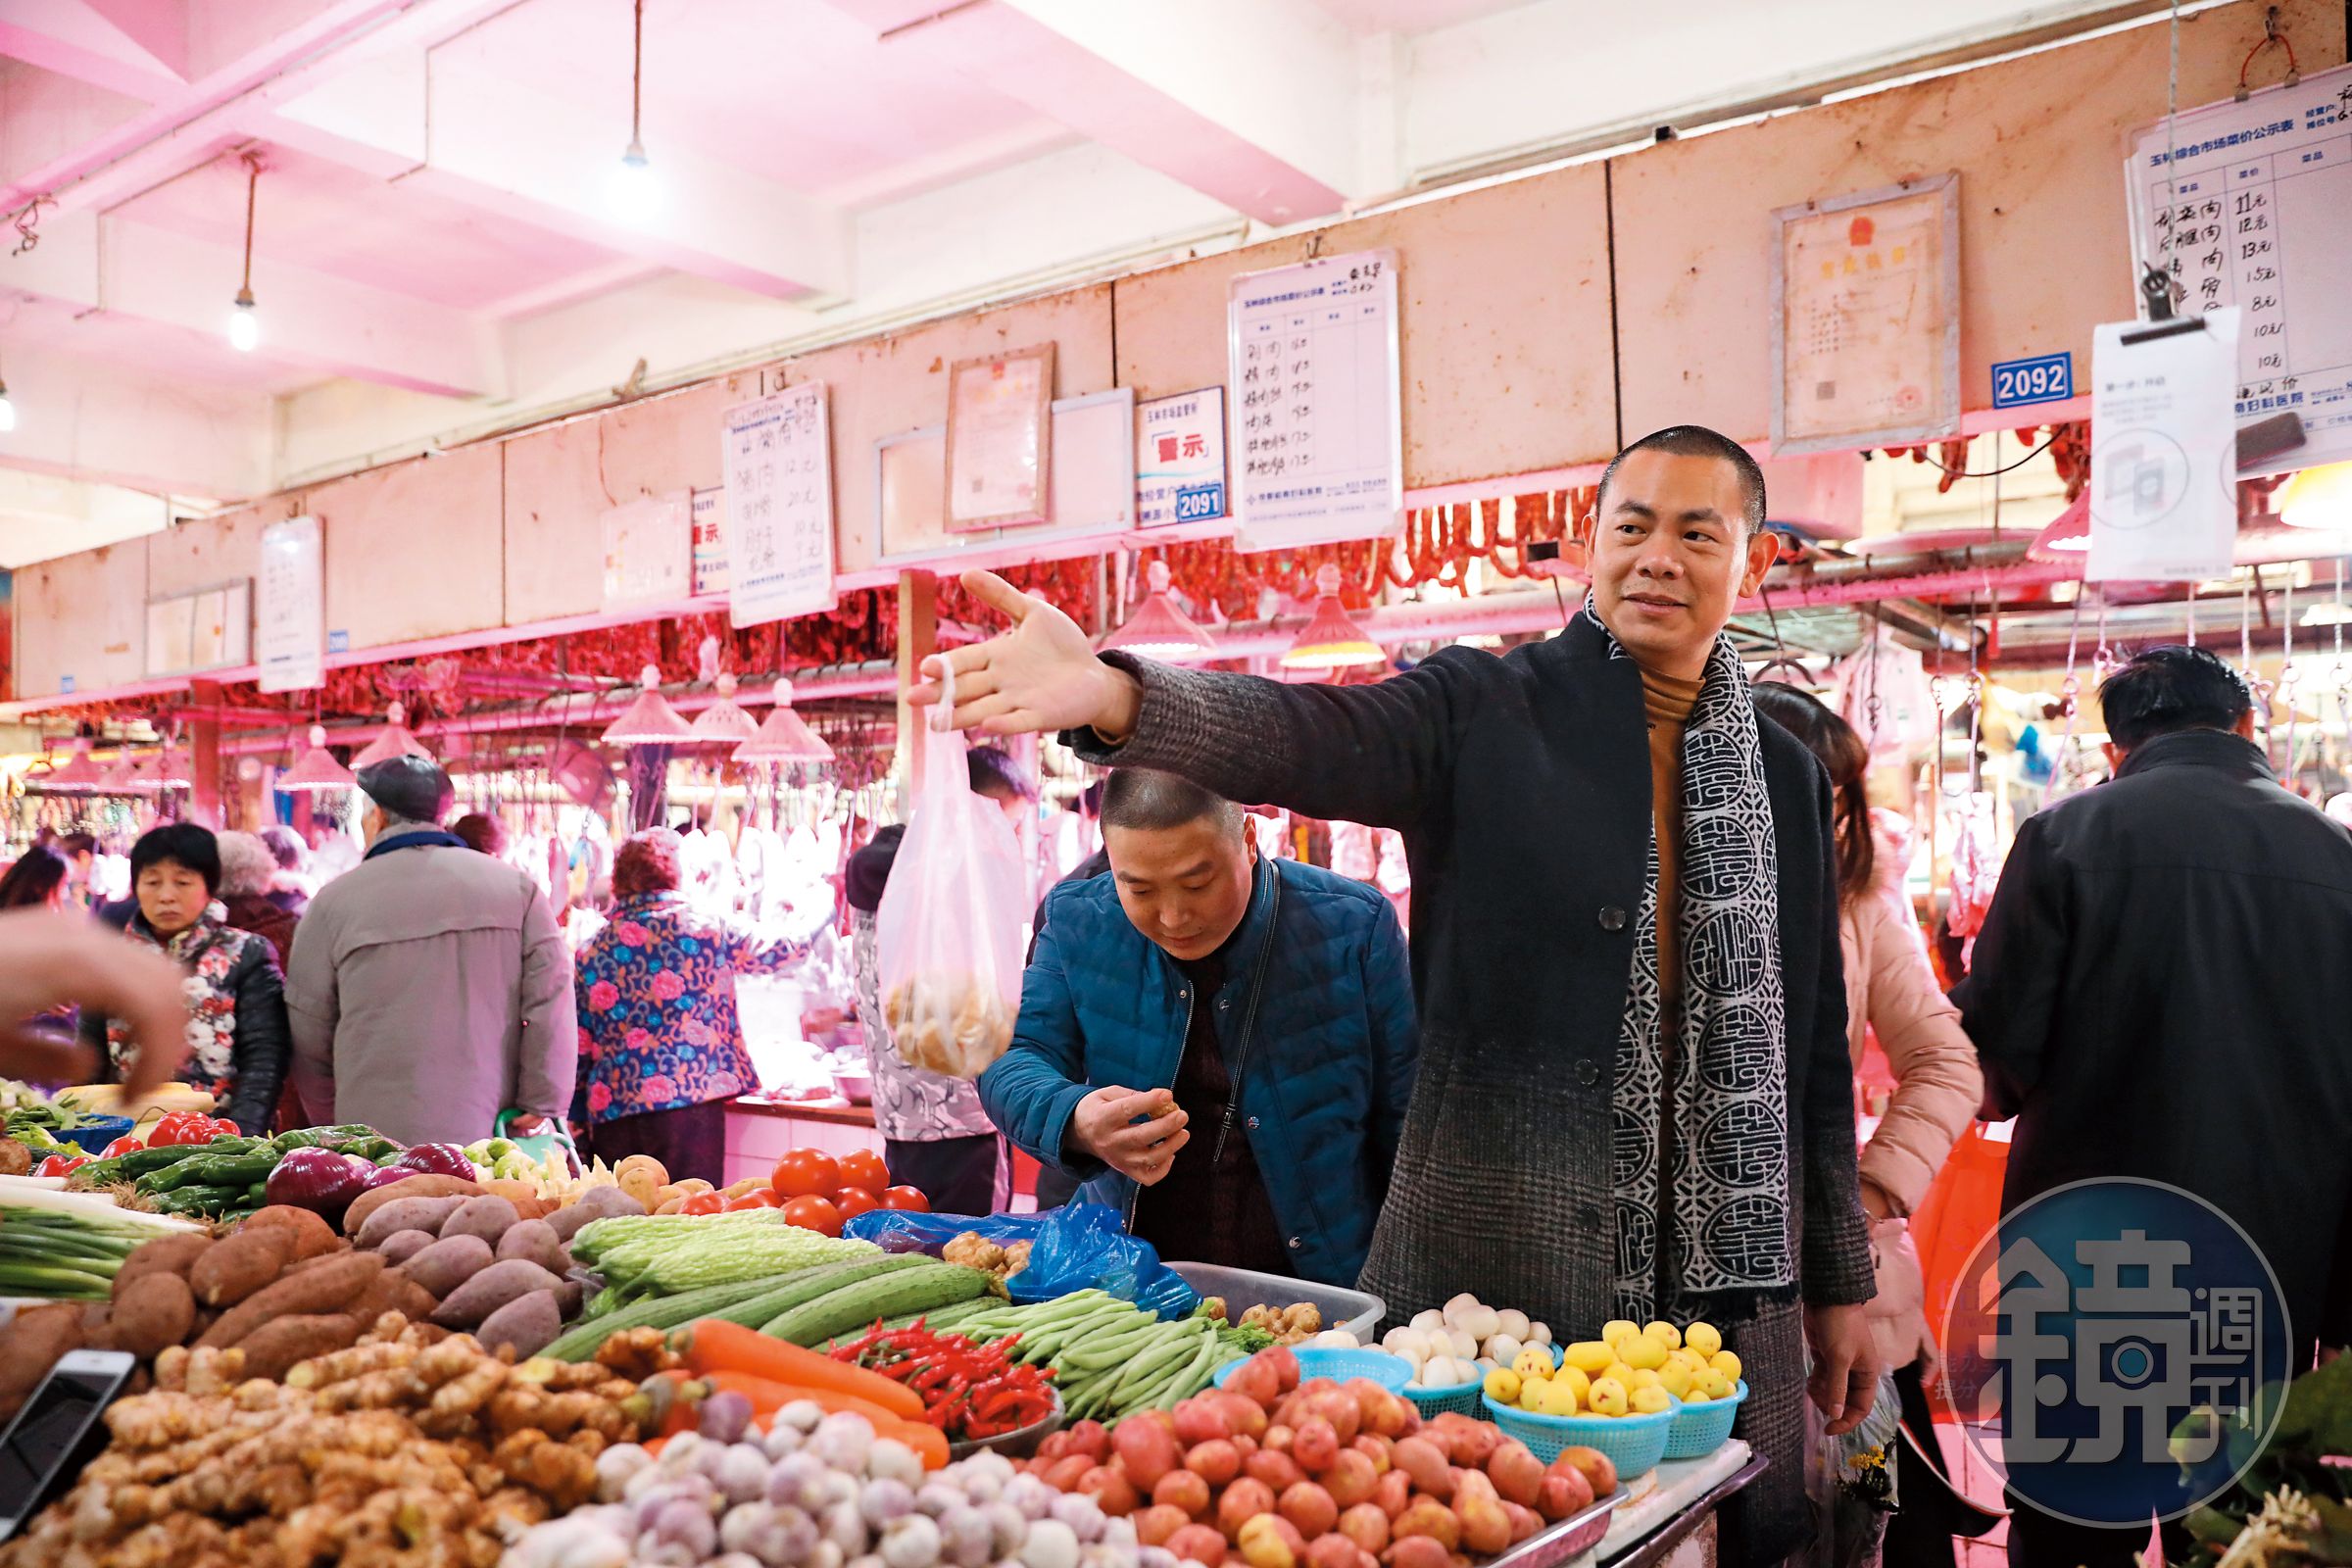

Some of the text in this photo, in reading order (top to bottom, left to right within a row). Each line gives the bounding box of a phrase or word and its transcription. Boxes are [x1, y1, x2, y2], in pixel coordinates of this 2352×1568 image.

[2241, 241, 2272, 260] 13元
[1998, 364, 2064, 400] 2092
[1181, 492, 1219, 517] 2091
